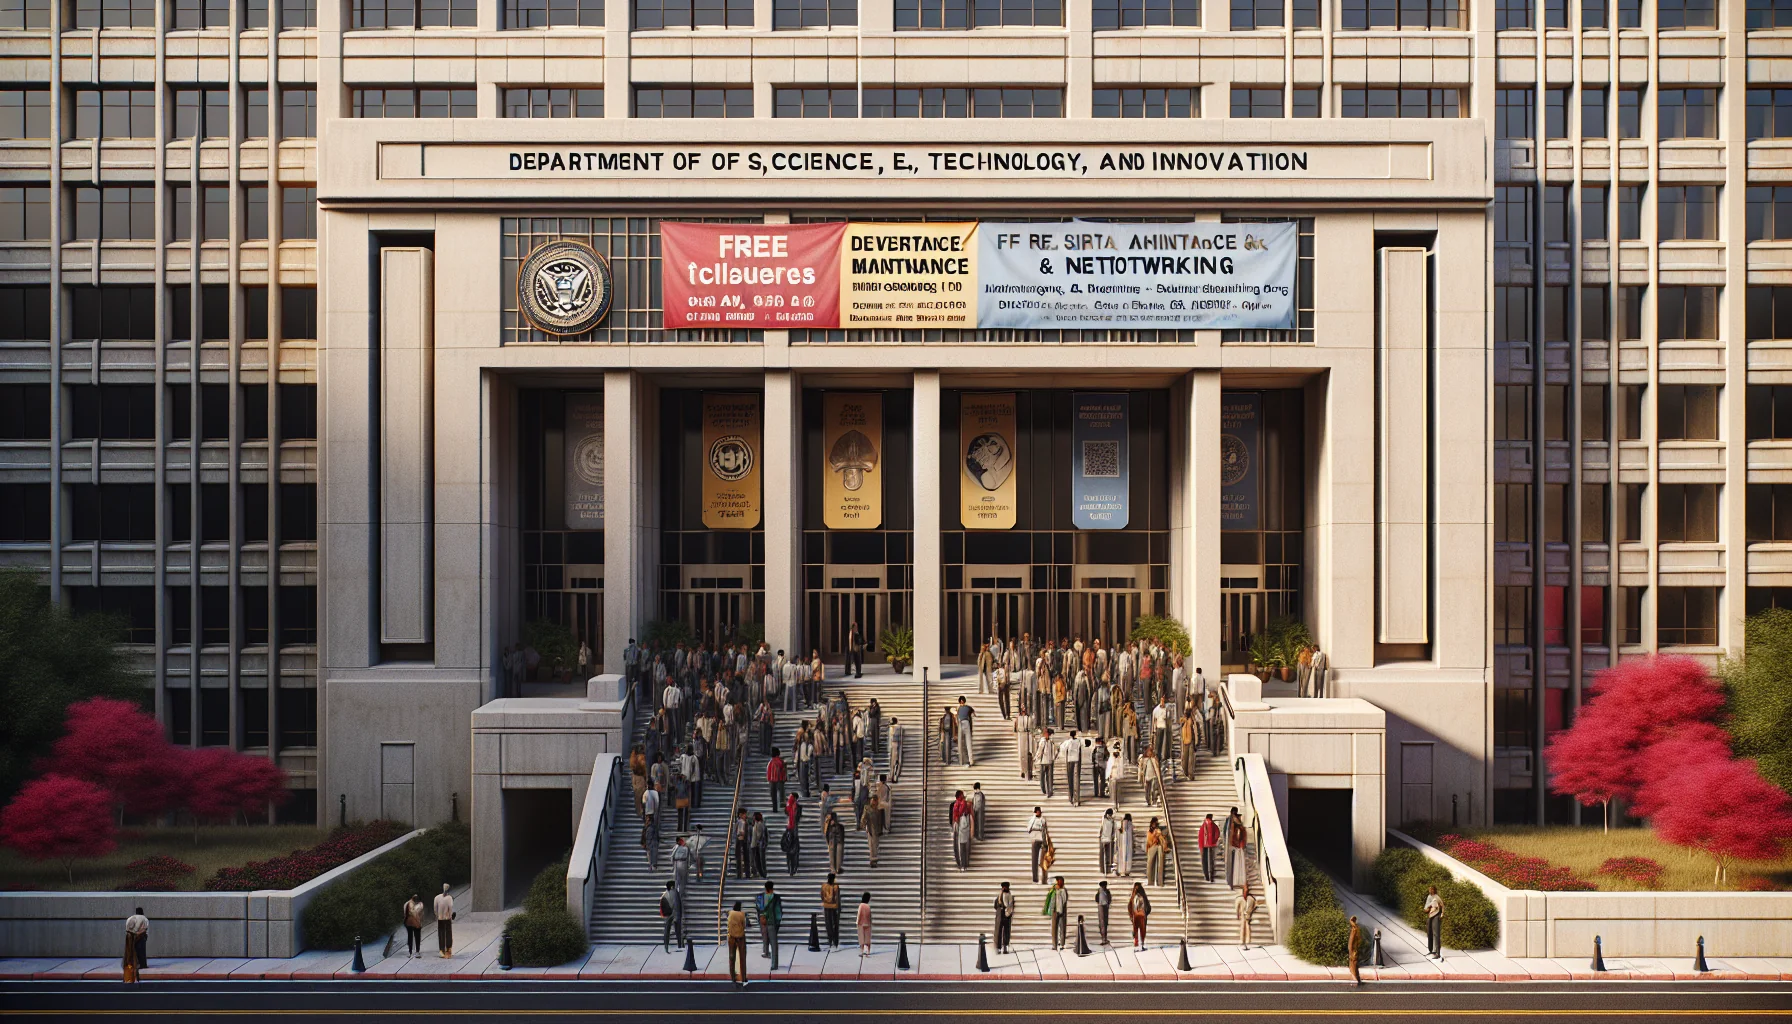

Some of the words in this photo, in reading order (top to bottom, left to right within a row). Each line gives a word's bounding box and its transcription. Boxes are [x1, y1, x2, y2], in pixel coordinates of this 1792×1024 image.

[509, 152, 664, 171] DEPARTMENT
[672, 152, 700, 171] OF
[711, 152, 740, 171] OF
[928, 152, 1088, 176] TECHNOLOGY,
[1099, 152, 1145, 171] AND
[719, 235, 788, 258] FREE
[1039, 257, 1054, 275] &
